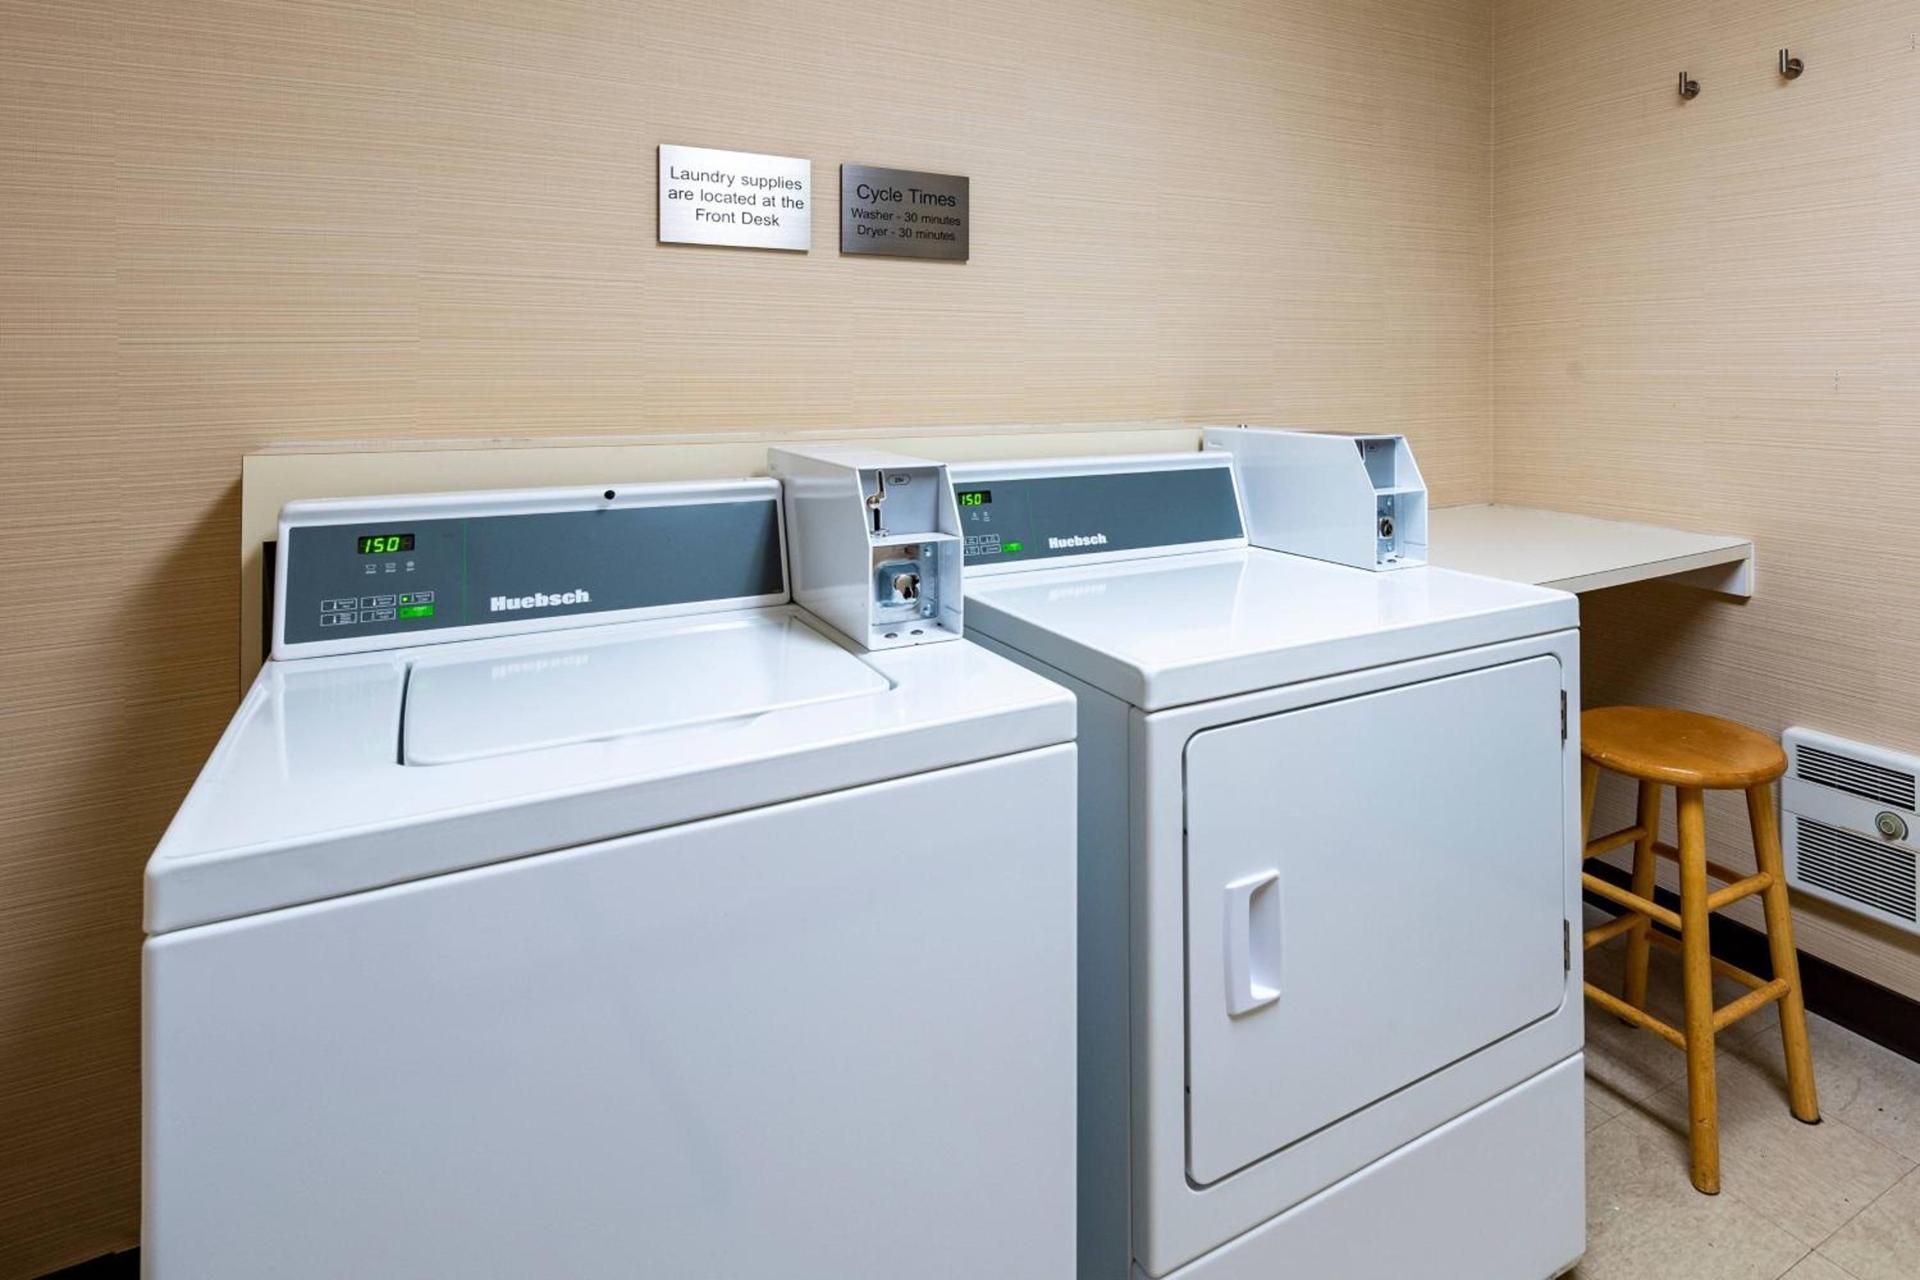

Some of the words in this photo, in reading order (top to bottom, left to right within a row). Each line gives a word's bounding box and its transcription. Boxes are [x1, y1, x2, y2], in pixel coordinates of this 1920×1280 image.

[670, 166, 735, 188] Laundry
[741, 175, 803, 190] supplies
[668, 188, 694, 200] are
[701, 189, 756, 206] located
[762, 195, 776, 207] at
[781, 196, 804, 209] the
[856, 183, 903, 204] Cycle
[907, 188, 957, 207] Times
[695, 208, 736, 224] Front
[741, 212, 780, 227] Desk
[851, 208, 894, 221] Washer
[904, 212, 918, 223] 30
[920, 214, 961, 226] minutes
[857, 224, 888, 238] Dryer
[898, 228, 912, 238] 30
[916, 230, 956, 241] minutes
[961, 493, 982, 506] 150
[364, 537, 400, 553] 150
[1048, 533, 1107, 549] Huebsch
[490, 588, 590, 611] Huebsch
